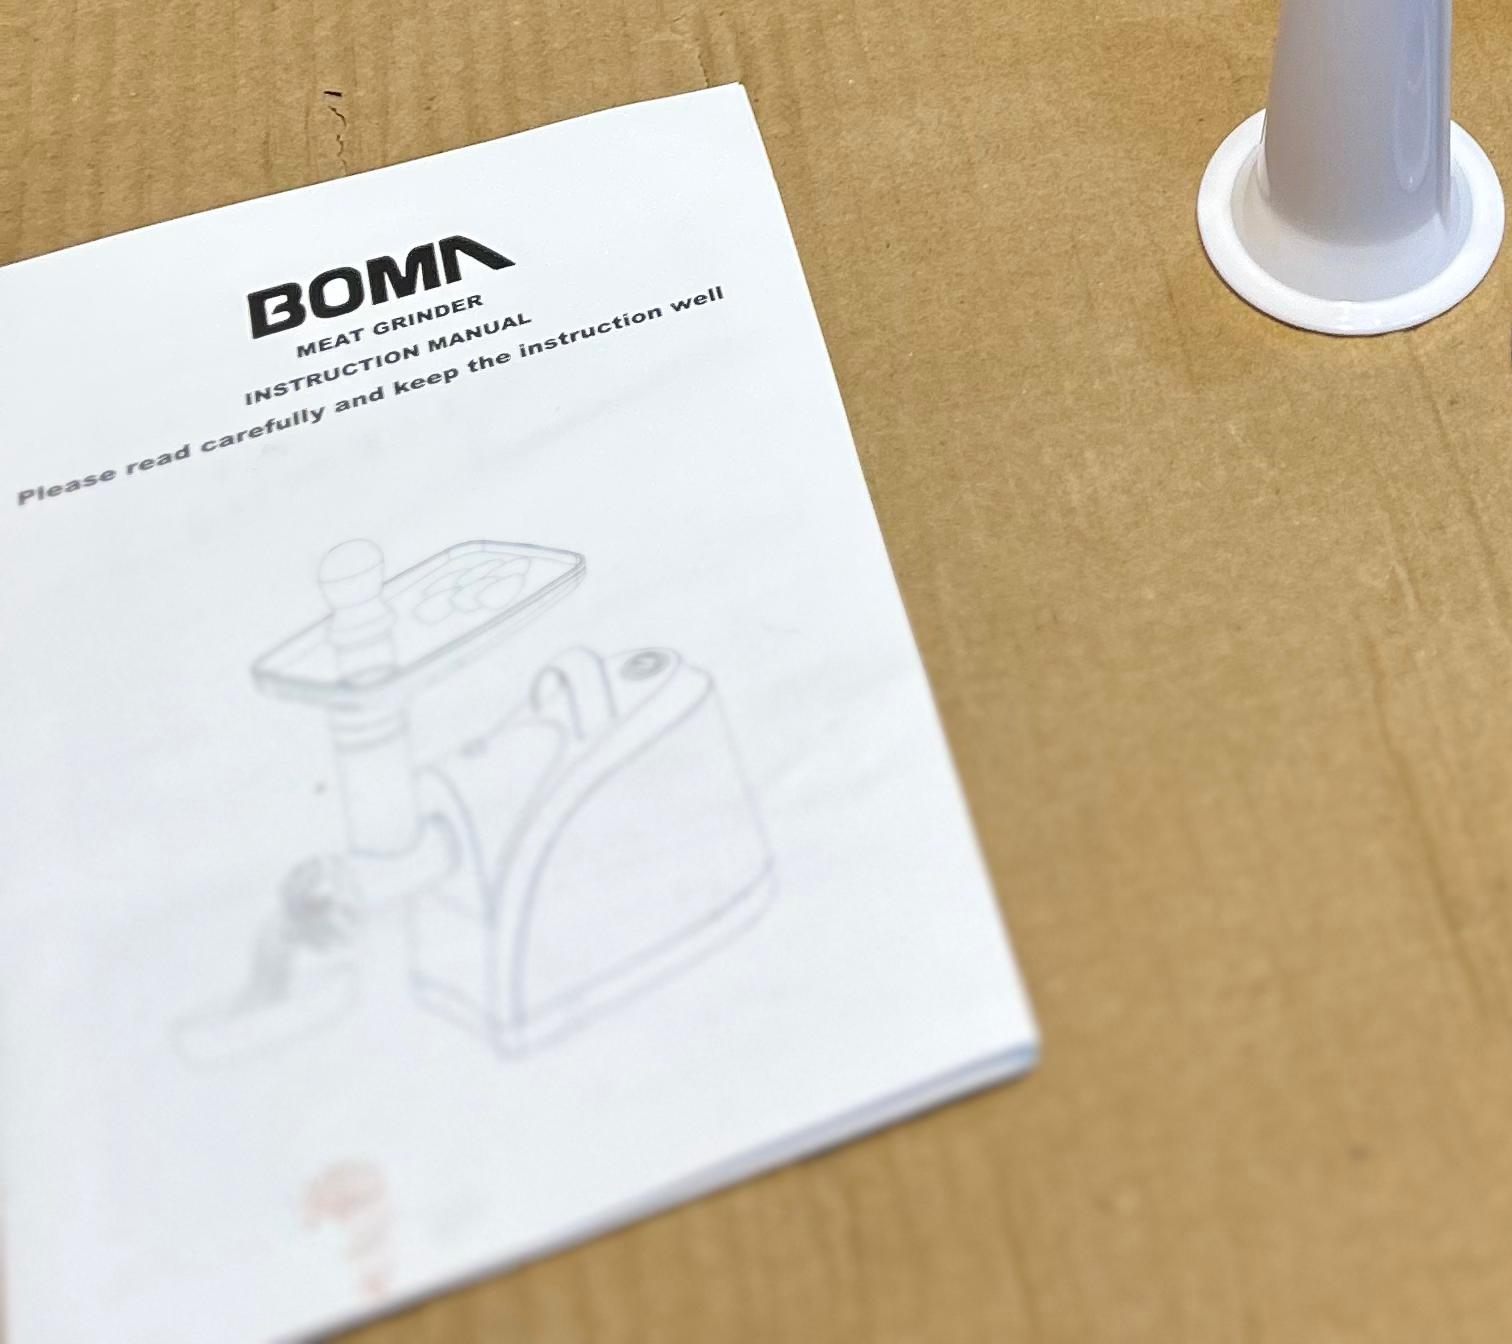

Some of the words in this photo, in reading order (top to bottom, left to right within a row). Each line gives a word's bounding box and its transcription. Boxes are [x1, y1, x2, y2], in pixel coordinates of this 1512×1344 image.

[247, 234, 516, 340] BOMA
[295, 328, 365, 359] MEAT
[373, 293, 485, 338] GRINDER
[17, 464, 118, 507] Please
[125, 443, 191, 477] read
[200, 404, 327, 455] carefully
[334, 385, 385, 414] and
[392, 365, 460, 398] keep
[467, 348, 512, 378] the
[517, 307, 663, 361] instruction
[670, 285, 725, 317] well
[243, 343, 420, 406] INSTRUCTION
[427, 312, 533, 354] MANUAL
